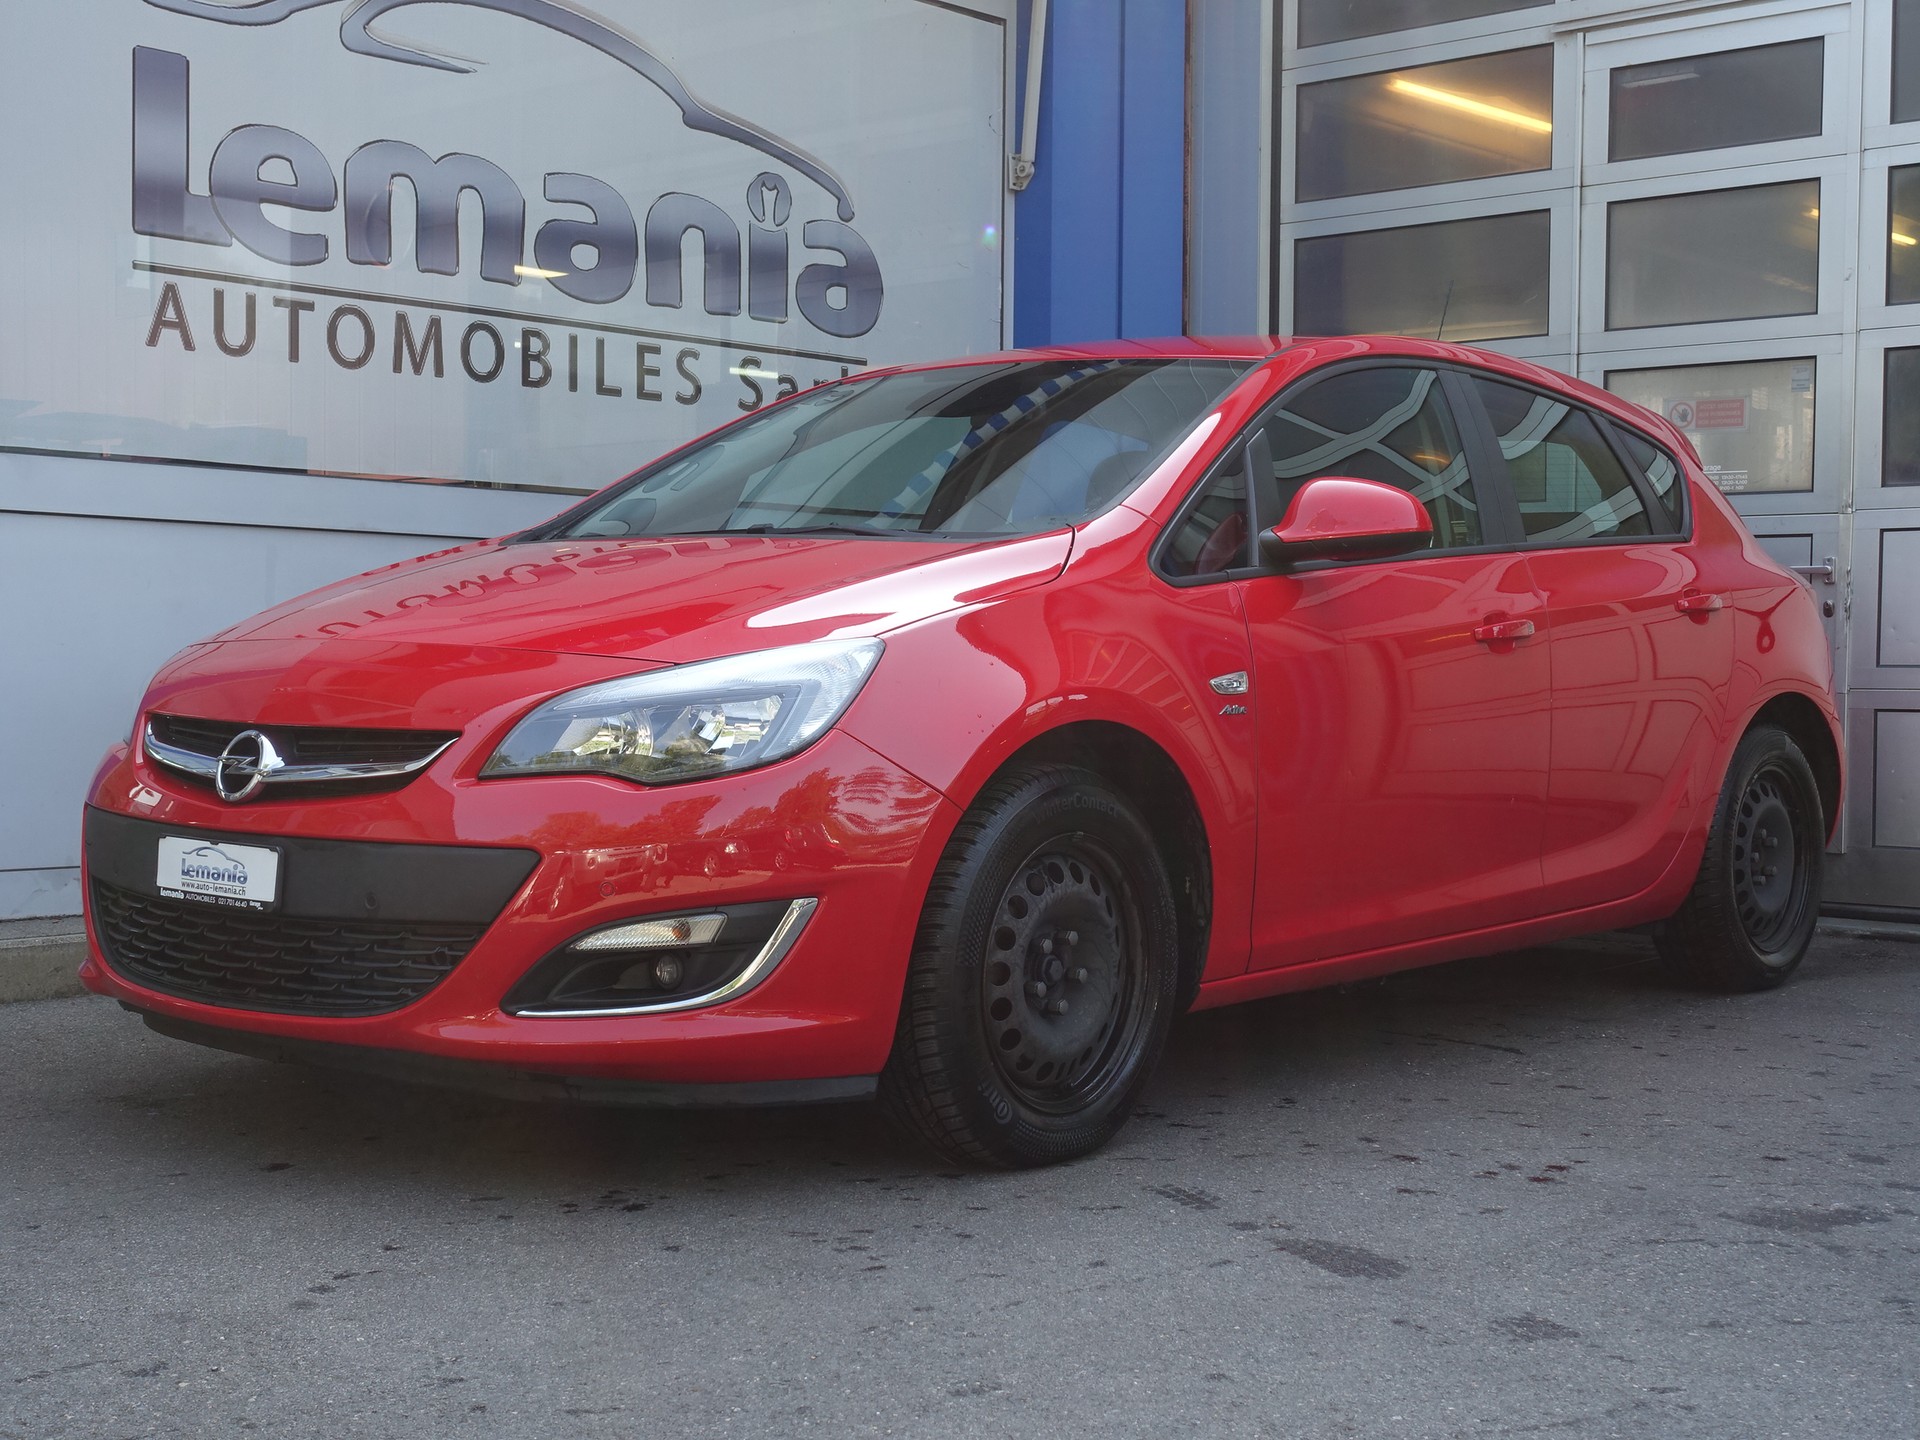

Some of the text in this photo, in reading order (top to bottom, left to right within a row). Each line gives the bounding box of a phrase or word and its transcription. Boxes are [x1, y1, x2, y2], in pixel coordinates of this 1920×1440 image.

[145, 281, 703, 406] AUTOMOBILES
[1032, 791, 1118, 825] WinterContact
[181, 881, 246, 896] www.auto-lemania.ch
[185, 893, 216, 904] AUTOMOBILES
